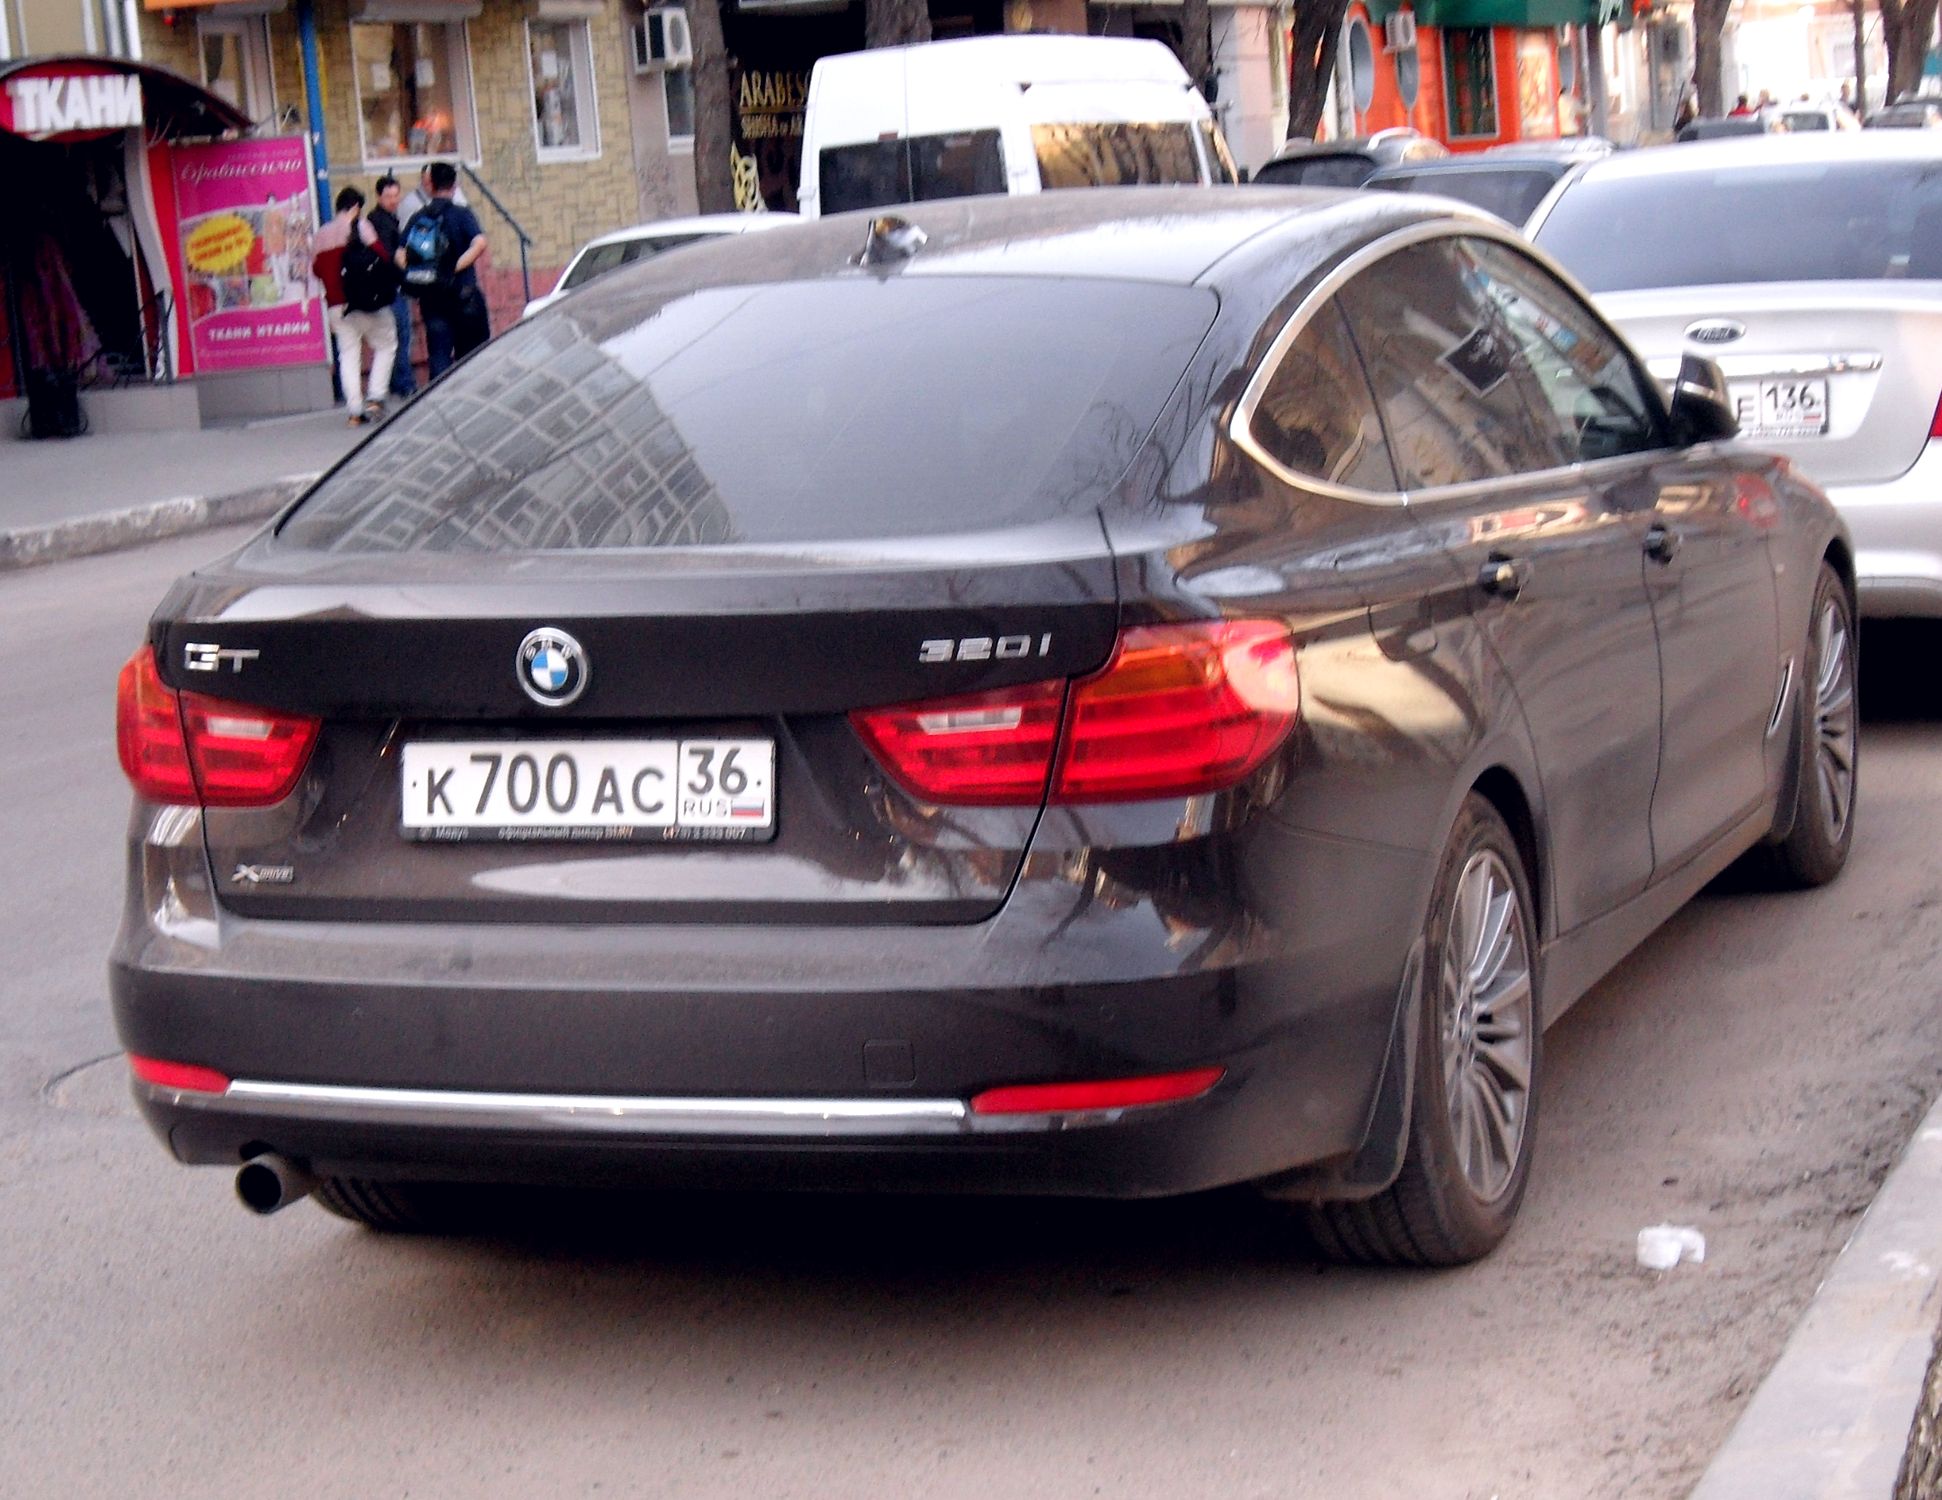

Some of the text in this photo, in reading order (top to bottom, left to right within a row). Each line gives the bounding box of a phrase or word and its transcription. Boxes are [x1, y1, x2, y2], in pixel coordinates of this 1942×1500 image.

[8, 73, 142, 132] ТКАНИ
[208, 321, 311, 341] ТКАНИ ИТАЛИИ
[1766, 384, 1815, 410] 136
[184, 642, 260, 673] GT
[687, 747, 748, 796] 36
[683, 799, 727, 817] RUS
